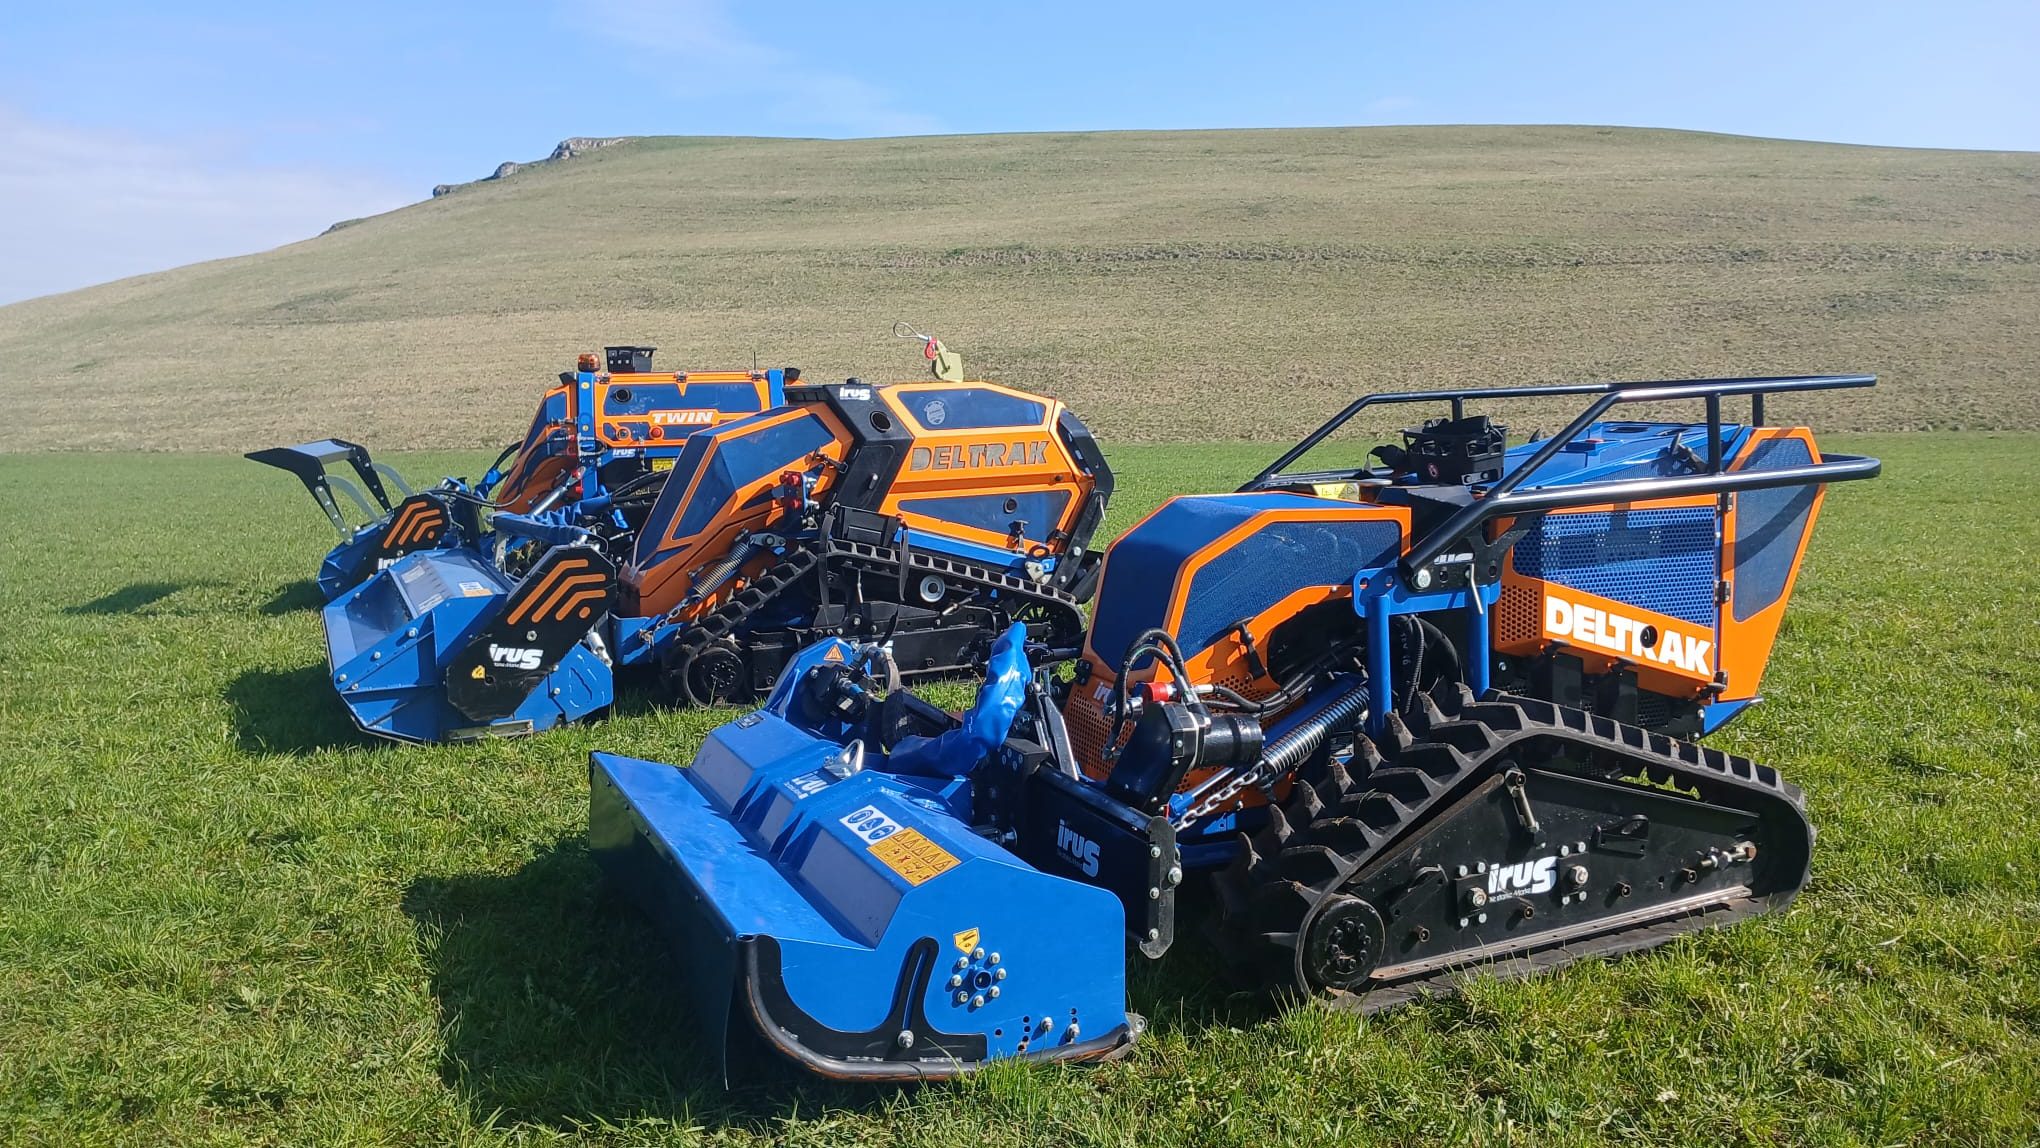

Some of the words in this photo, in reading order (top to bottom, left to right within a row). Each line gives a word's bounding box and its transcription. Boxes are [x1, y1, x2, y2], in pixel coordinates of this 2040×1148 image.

[652, 411, 714, 424] TWIN
[910, 441, 1049, 472] DELTRAK
[1545, 595, 1712, 676] DELTRAK
[489, 644, 544, 670] irus
[1057, 818, 1101, 878] irus
[1488, 855, 1558, 894] irus
